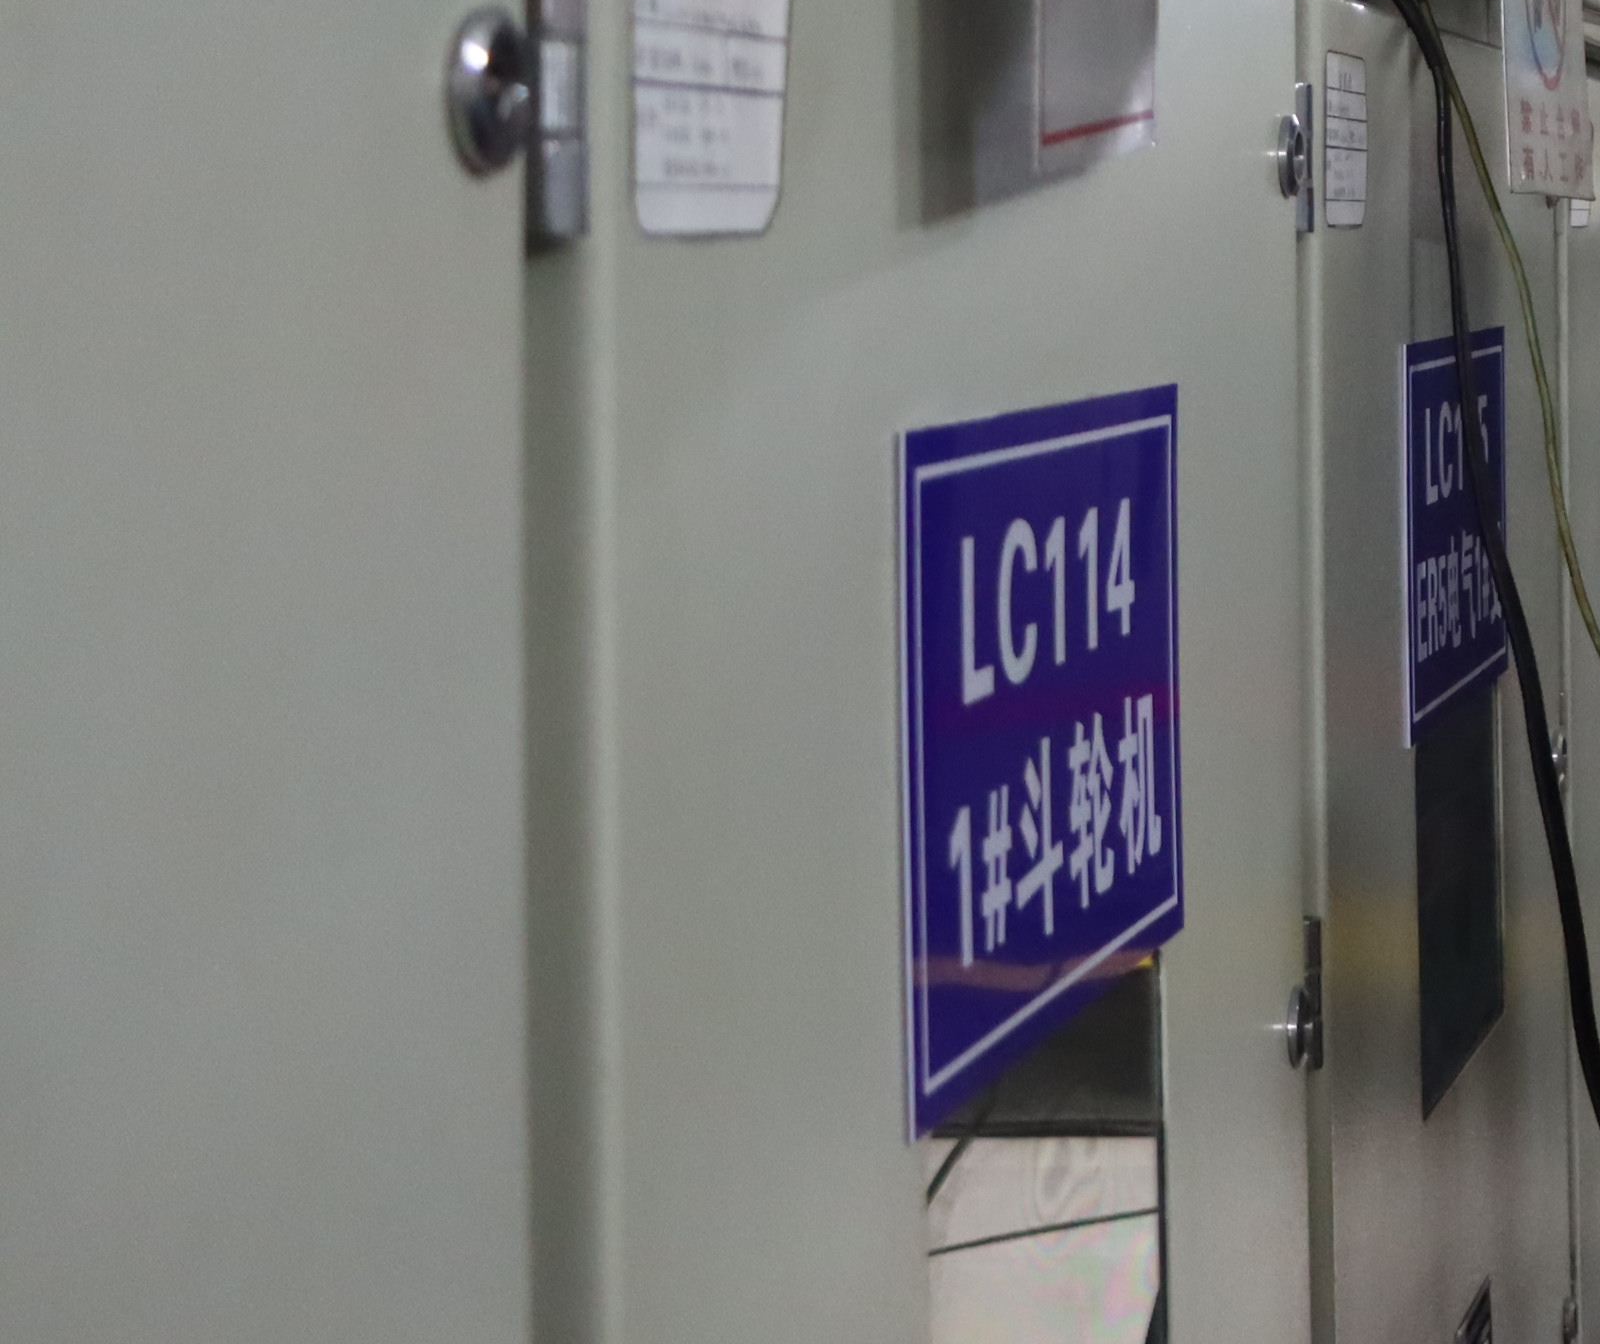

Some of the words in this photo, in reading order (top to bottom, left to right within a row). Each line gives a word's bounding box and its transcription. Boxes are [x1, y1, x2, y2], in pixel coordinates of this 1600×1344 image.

[1425, 394, 1489, 506] LC15
[961, 497, 1136, 706] LC114
[950, 693, 1162, 968] 1#斗轮机
